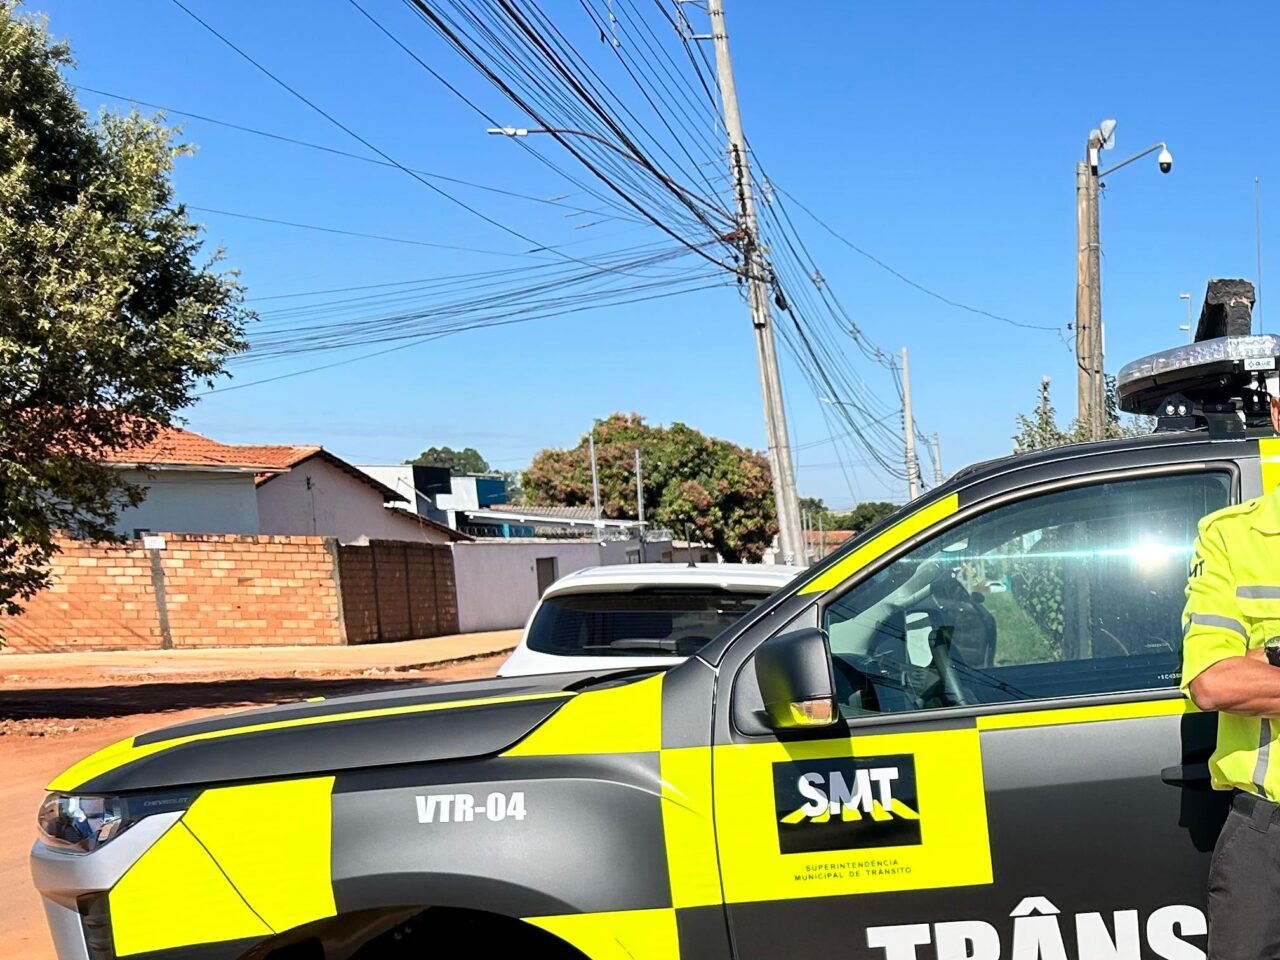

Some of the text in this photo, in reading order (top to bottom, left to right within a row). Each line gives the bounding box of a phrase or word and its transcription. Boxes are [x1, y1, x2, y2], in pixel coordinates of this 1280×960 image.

[798, 767, 899, 817] SMT
[415, 792, 527, 823] VTR-04
[794, 872, 844, 881] MUNICIPAL
[866, 866, 912, 876] TRÂNSITO
[805, 859, 899, 872] SUPERINTENDÊNCIA
